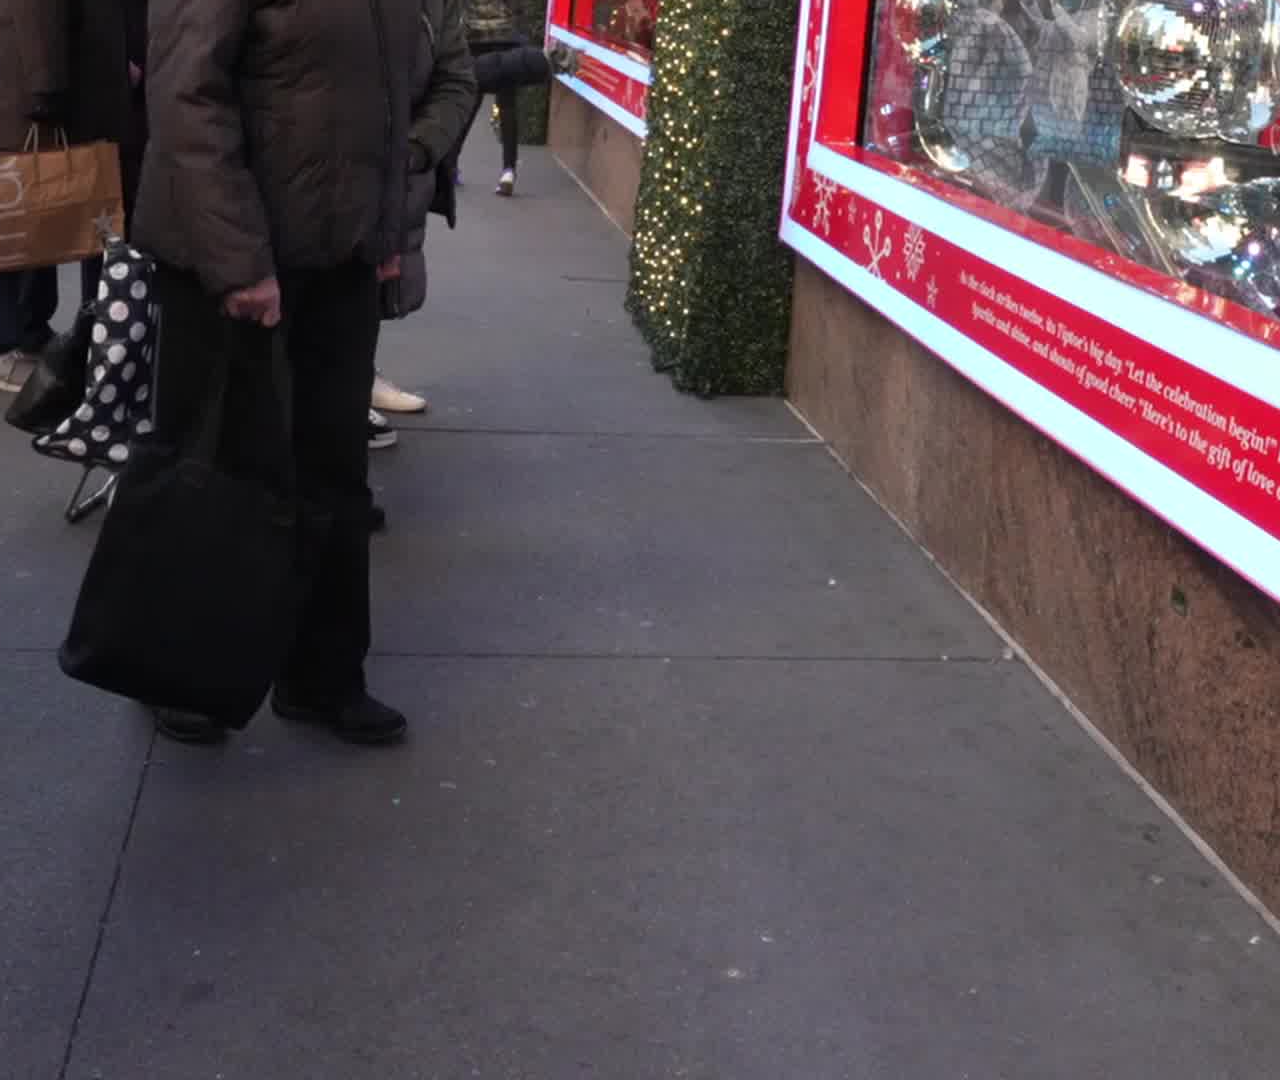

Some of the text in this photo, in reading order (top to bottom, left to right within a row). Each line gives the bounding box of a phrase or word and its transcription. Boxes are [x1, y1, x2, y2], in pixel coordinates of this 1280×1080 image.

[1032, 342, 1049, 360] and
[1075, 364, 1087, 385] of
[1084, 371, 1109, 395] good
[1108, 383, 1137, 413] cheer,
[1138, 400, 1175, 434] “Here’s
[1175, 422, 1188, 442] to
[1188, 429, 1209, 454] the
[1206, 443, 1232, 470] gift
[1232, 458, 1249, 482] of
[1247, 461, 1276, 495] love
[1089, 338, 1105, 367] big
[1126, 360, 1145, 385] “Let
[1145, 373, 1163, 395] the
[1163, 386, 1227, 432] celebration
[1228, 416, 1277, 455] begin!”
